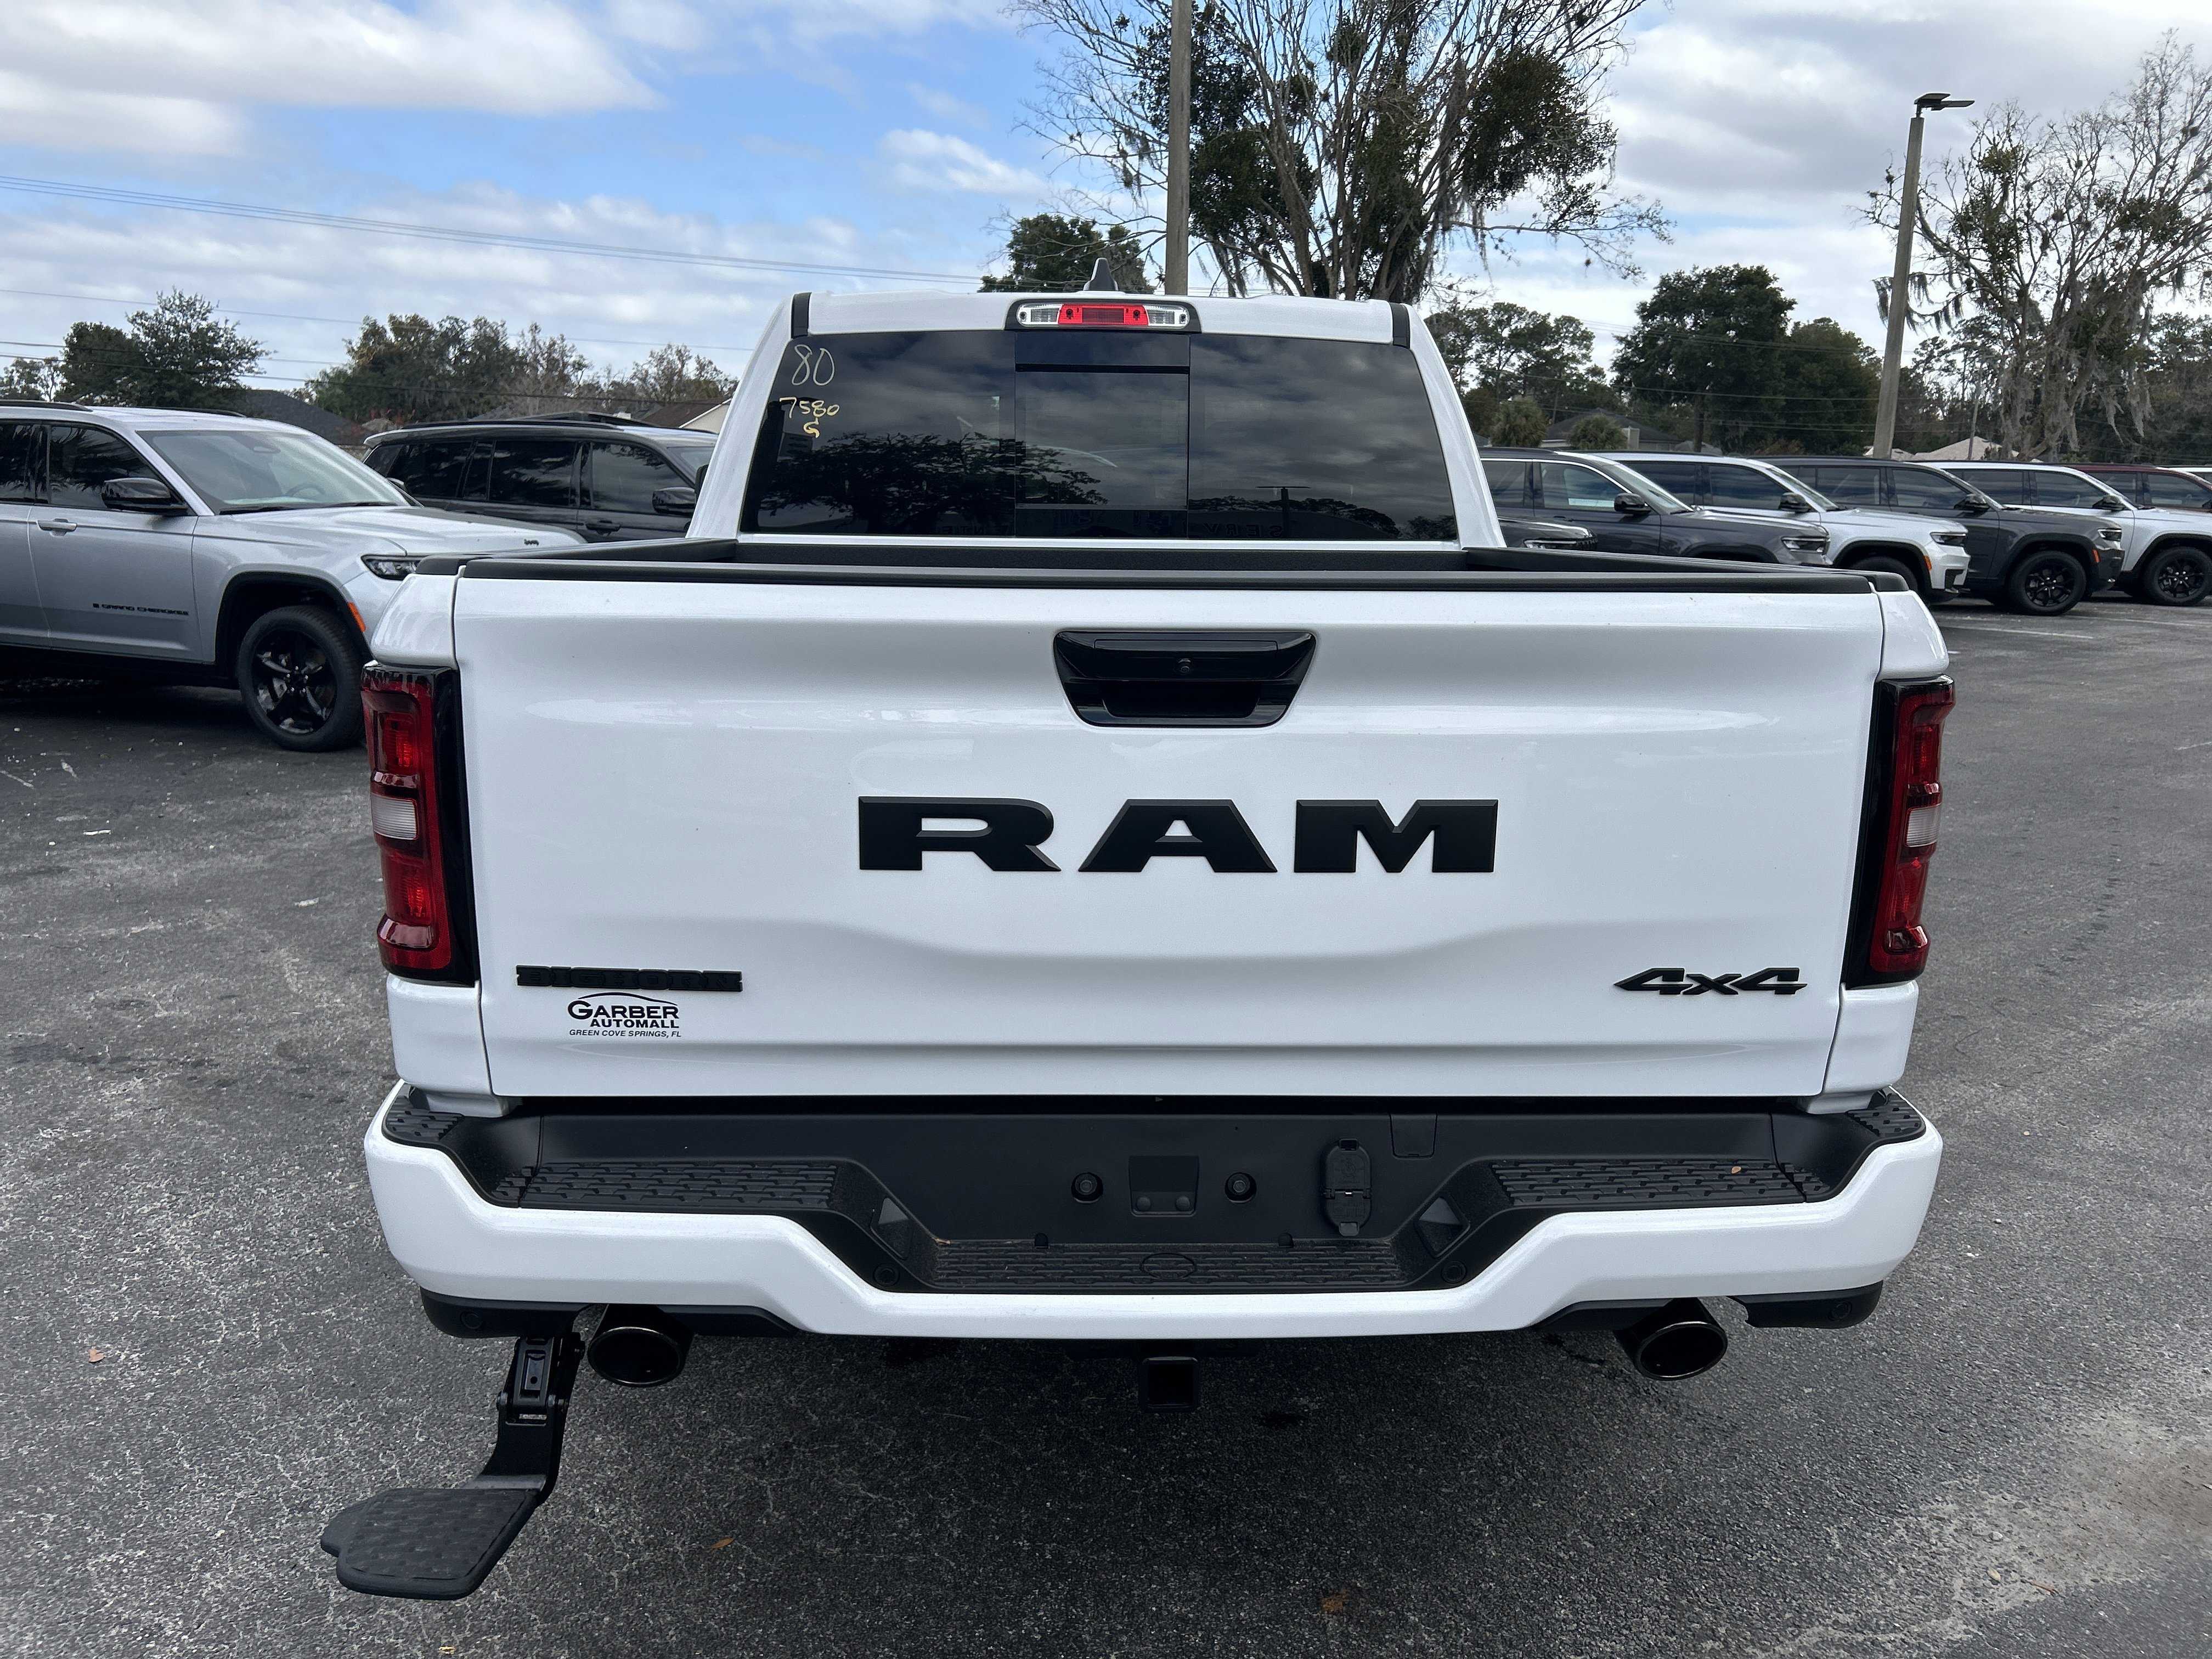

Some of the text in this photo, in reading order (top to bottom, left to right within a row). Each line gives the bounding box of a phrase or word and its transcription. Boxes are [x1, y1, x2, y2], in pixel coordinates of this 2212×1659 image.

[792, 344, 834, 386] 80
[779, 397, 840, 419] 7580
[858, 795, 1500, 873] RAM
[1613, 967, 1808, 995] 4x4
[568, 1000, 680, 1020] GARBER
[590, 1019, 680, 1029] AUTOMALL
[628, 1030, 669, 1039] SPRINGS,
